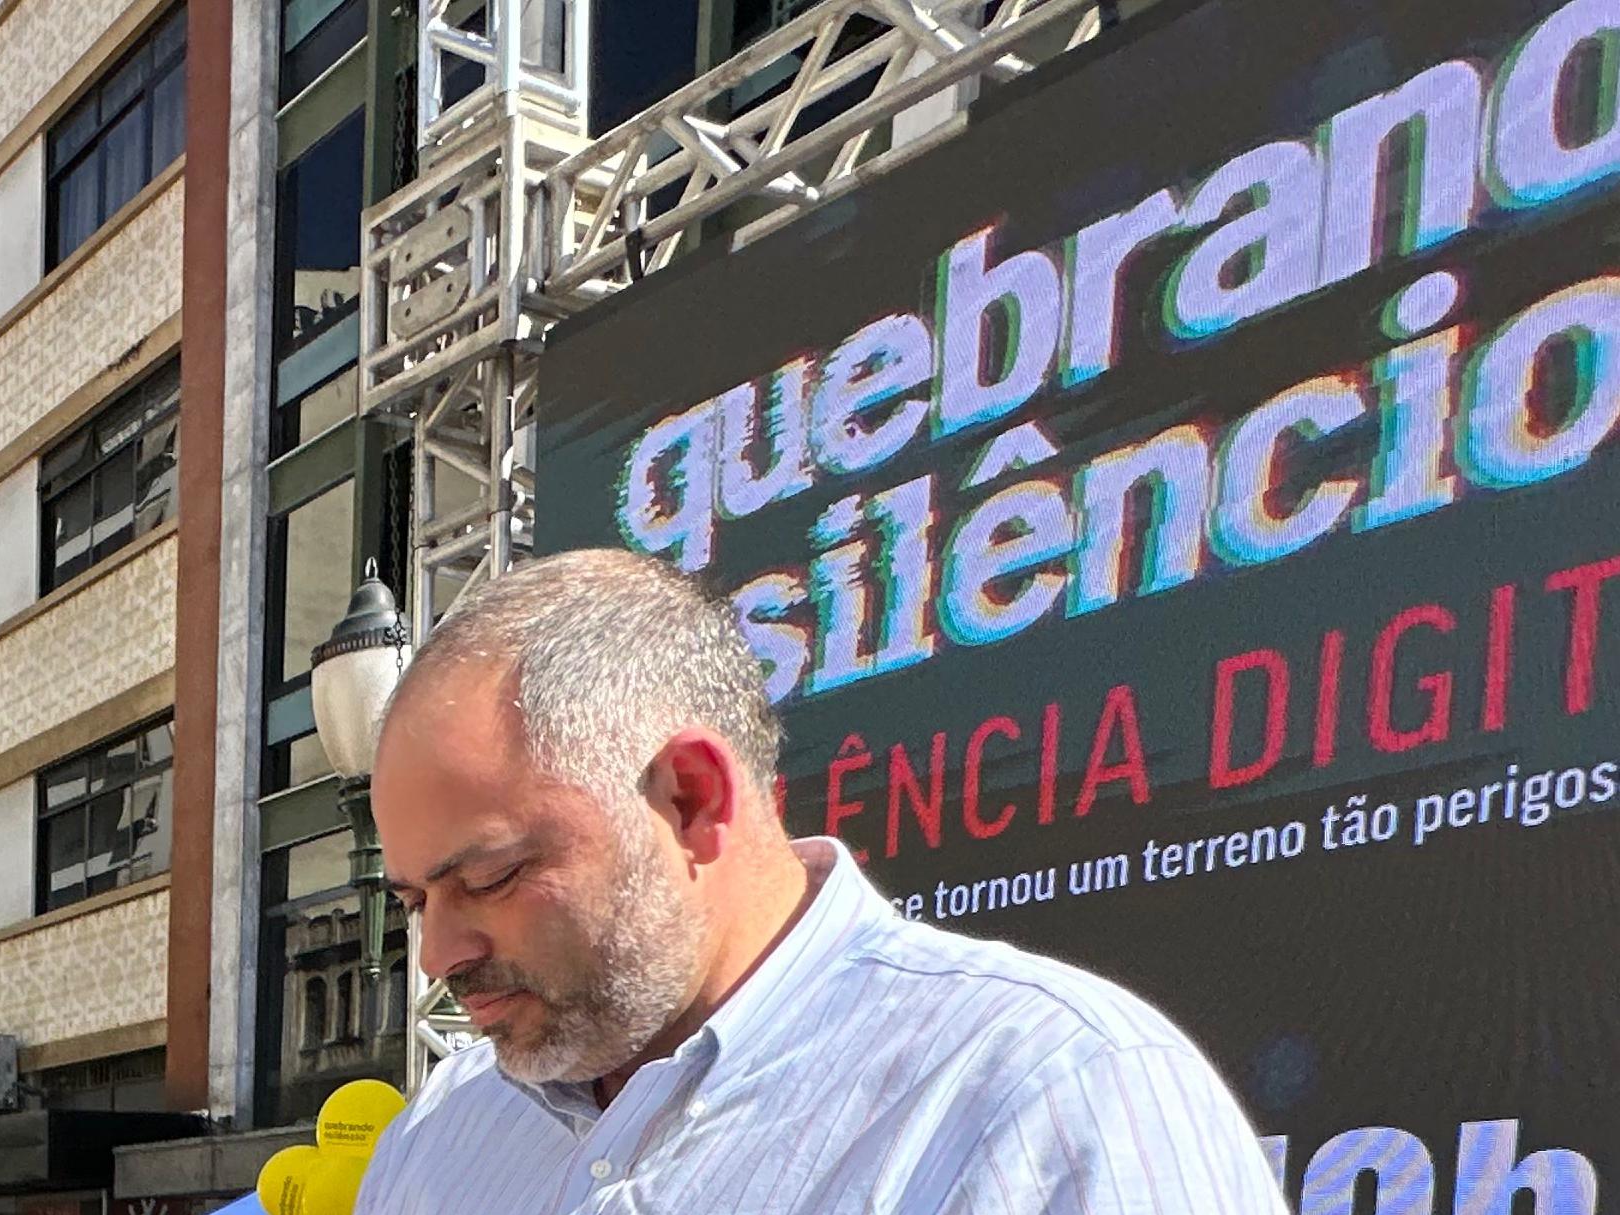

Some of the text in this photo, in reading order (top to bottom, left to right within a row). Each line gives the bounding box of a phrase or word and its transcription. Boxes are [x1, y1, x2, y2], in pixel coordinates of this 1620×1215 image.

[775, 555, 1620, 864] ÊNCIA DIGIT
[935, 867, 1057, 921] tornou
[1068, 853, 1130, 896] um
[1142, 820, 1306, 883] terreno
[1321, 793, 1399, 850] tão
